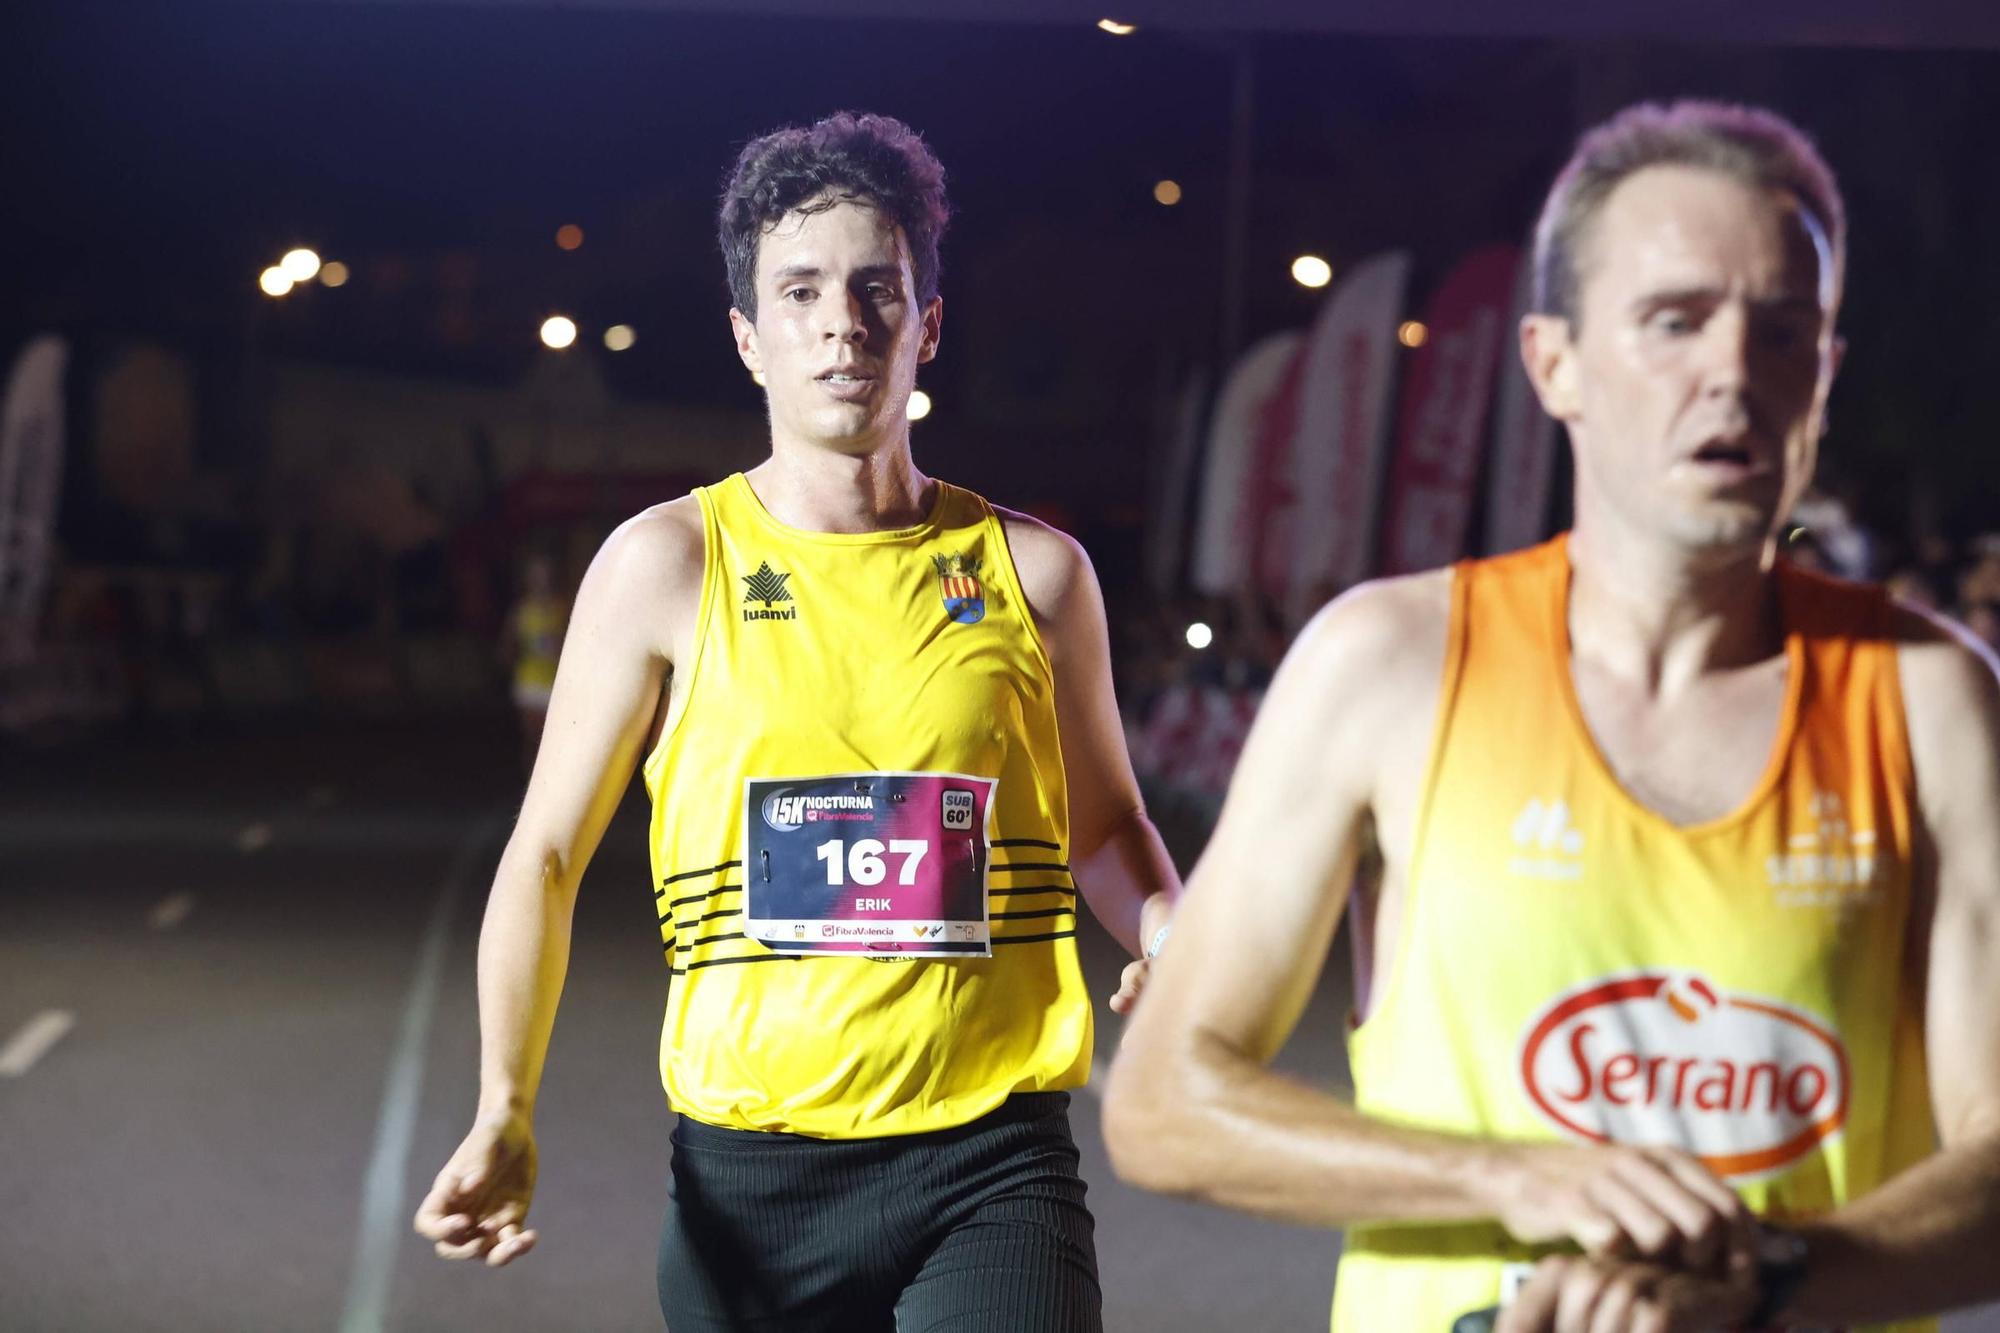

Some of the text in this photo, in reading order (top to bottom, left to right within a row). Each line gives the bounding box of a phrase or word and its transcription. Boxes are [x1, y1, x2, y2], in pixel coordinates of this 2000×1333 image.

[743, 606, 796, 622] luanvi
[946, 795, 971, 807] SUB
[771, 796, 874, 824] 15K NOCTURNA
[946, 808, 970, 824] 60'
[816, 838, 929, 886] 167
[855, 898, 892, 912] ERIK
[835, 926, 894, 936] FibraValencia
[1556, 1023, 1828, 1117] Serrano
